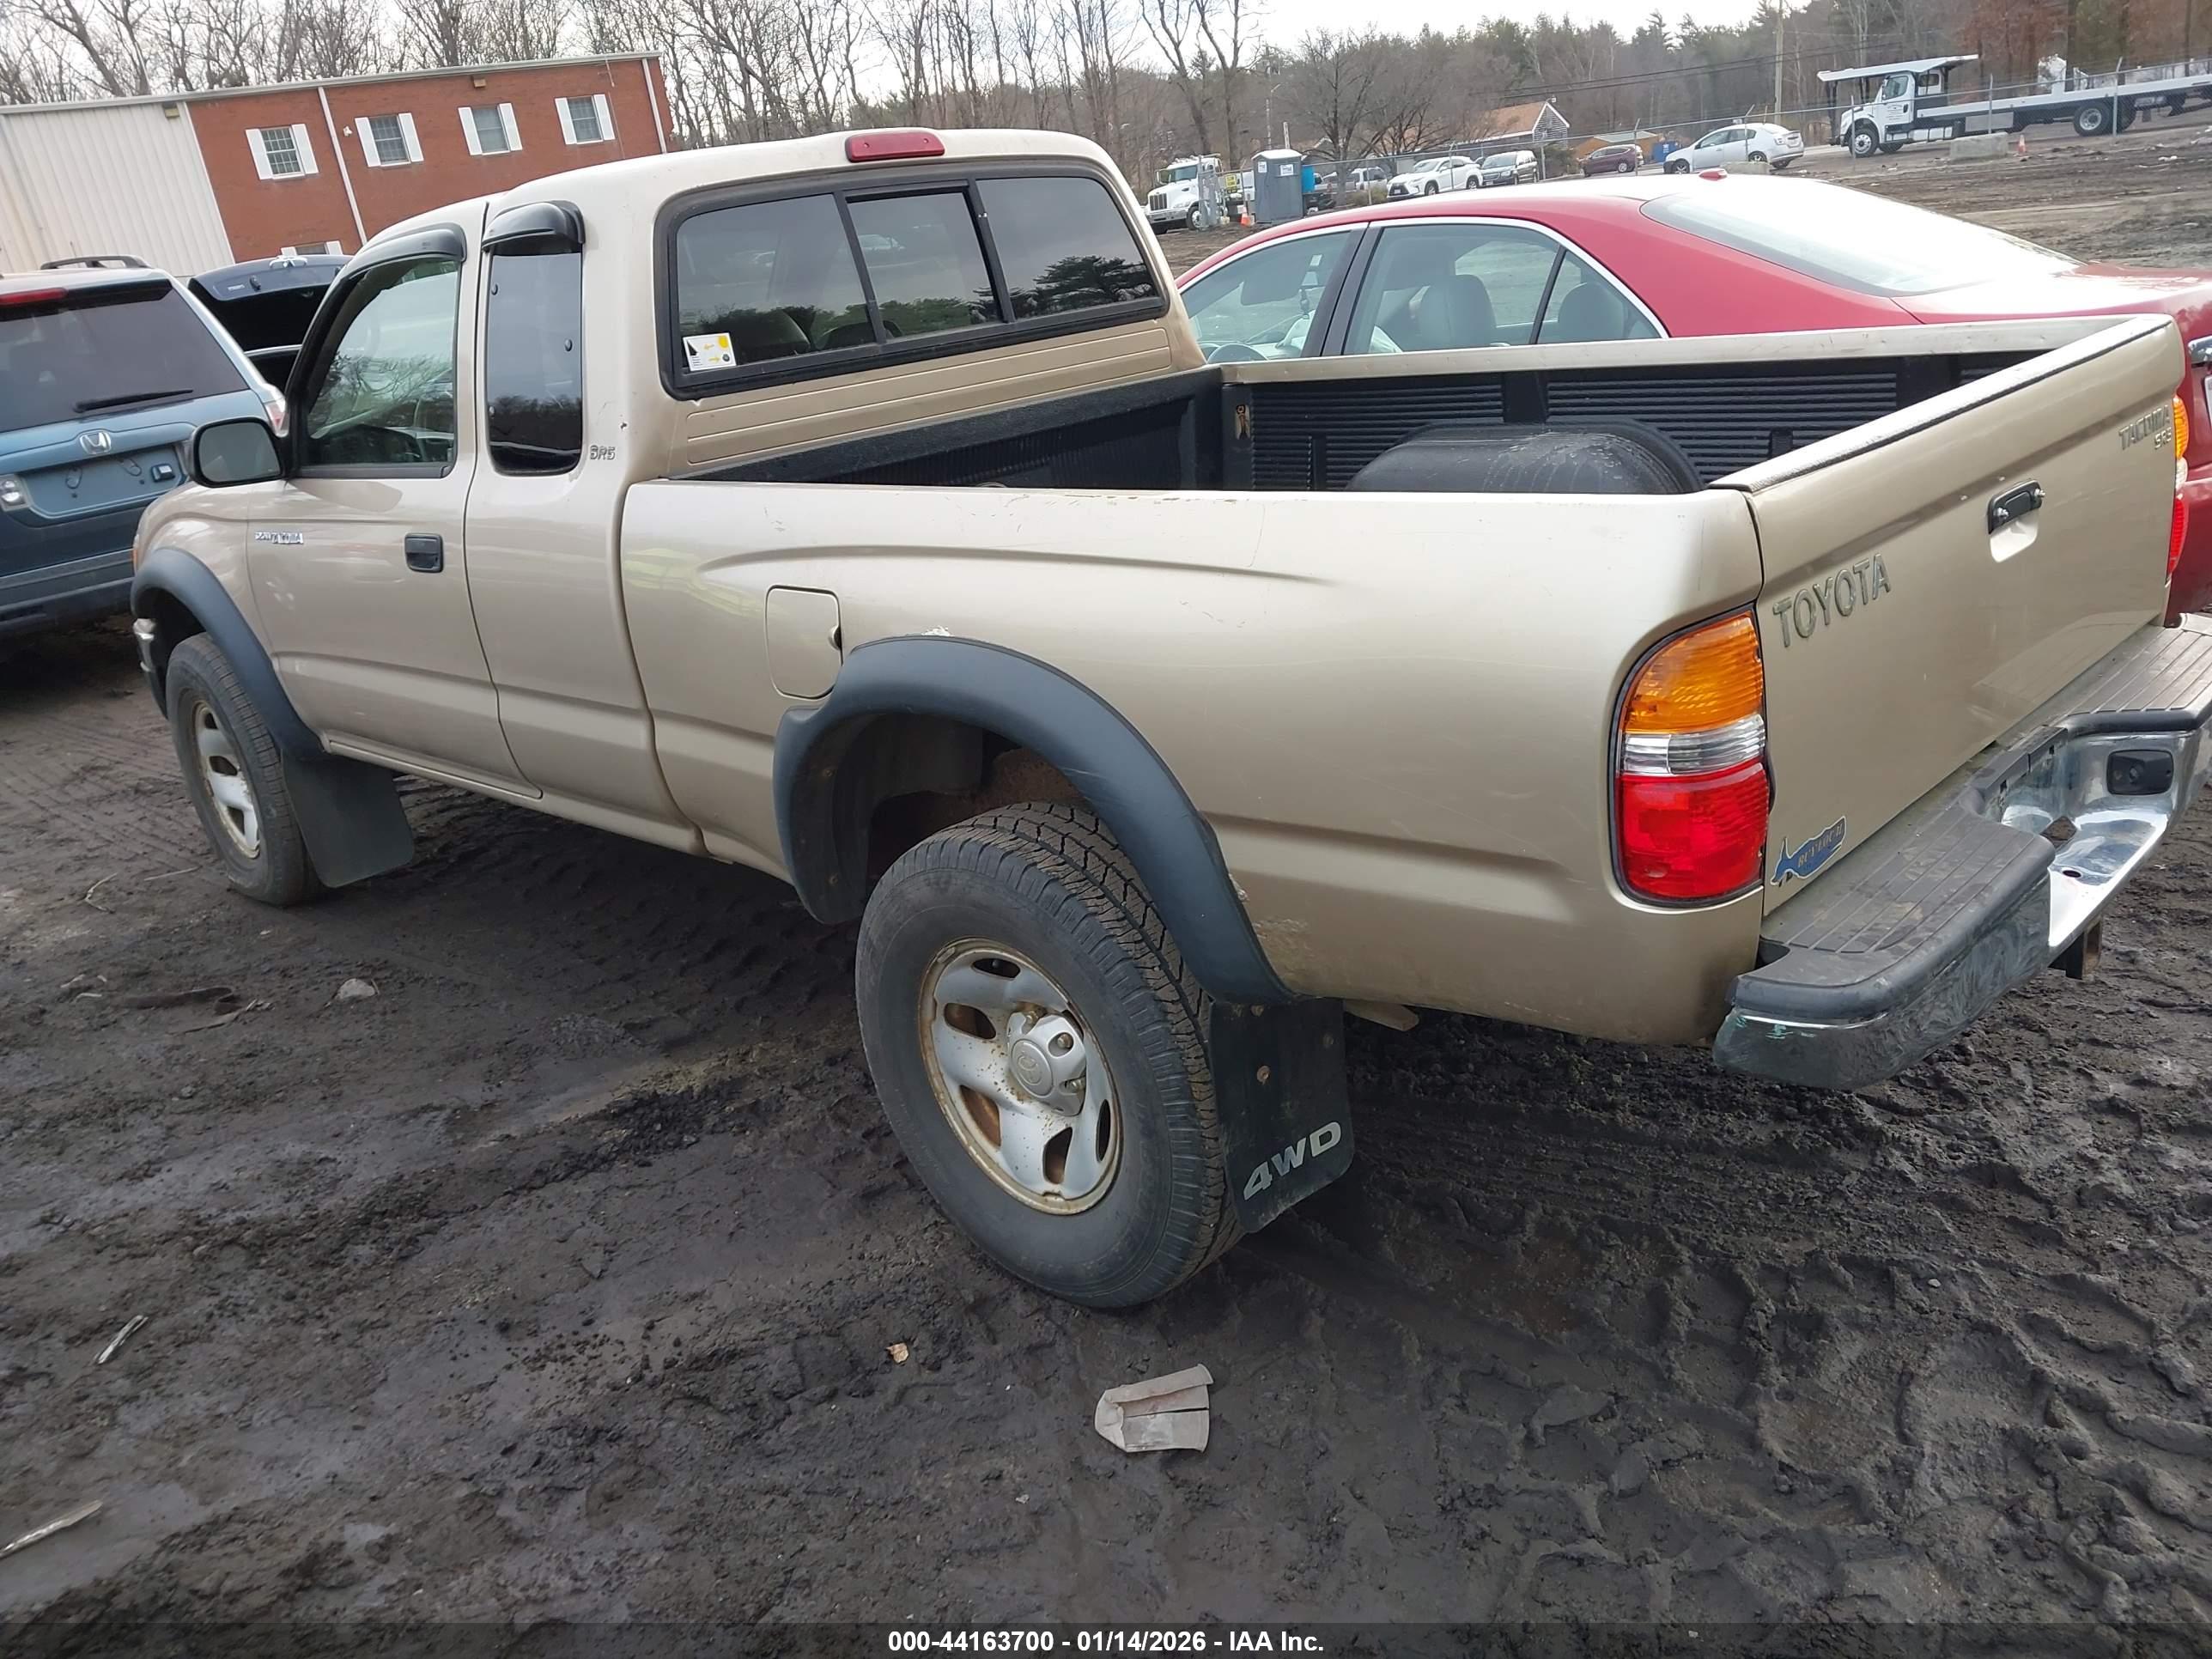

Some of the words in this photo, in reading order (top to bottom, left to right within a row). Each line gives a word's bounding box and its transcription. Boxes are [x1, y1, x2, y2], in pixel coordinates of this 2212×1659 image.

[590, 445, 617, 461] SR5
[1772, 553, 1891, 648] TOYOTA
[1243, 1121, 1341, 1201] 4WD
